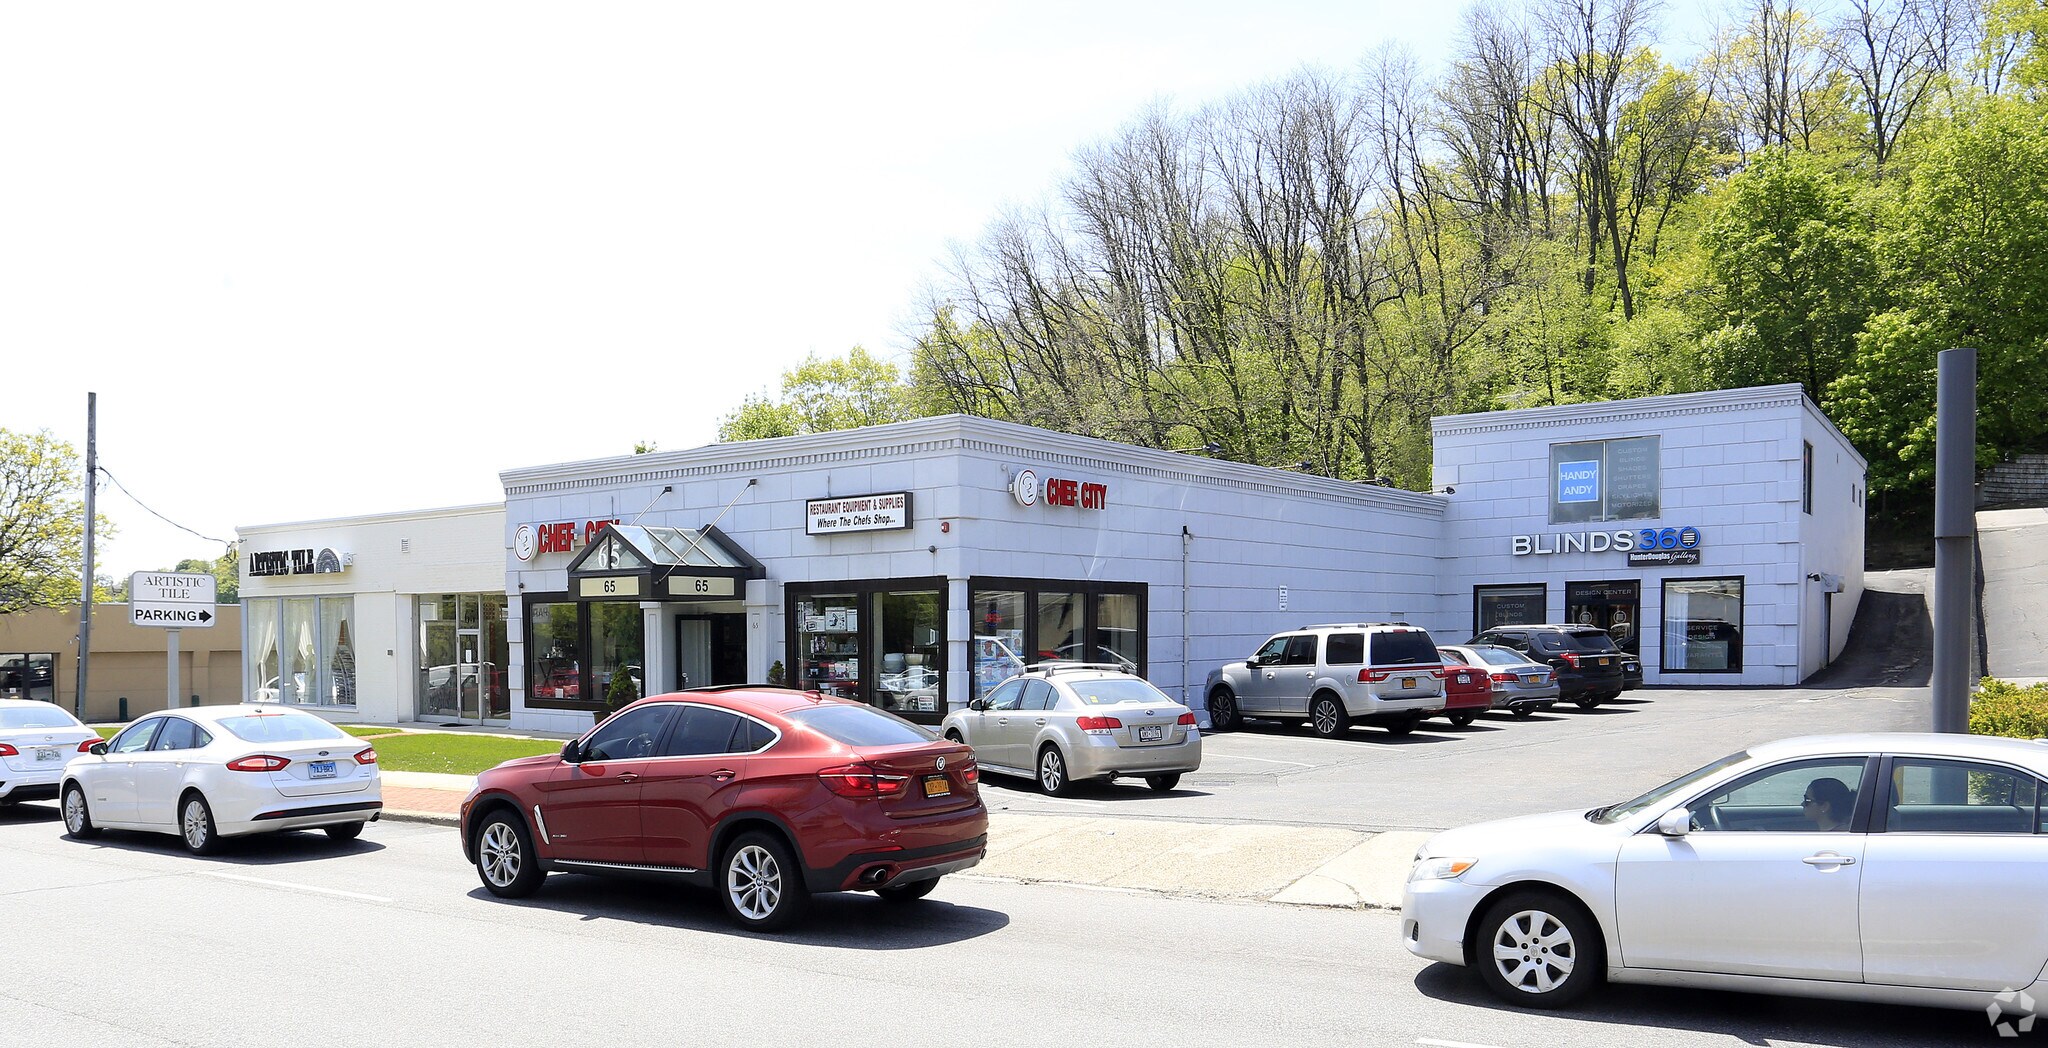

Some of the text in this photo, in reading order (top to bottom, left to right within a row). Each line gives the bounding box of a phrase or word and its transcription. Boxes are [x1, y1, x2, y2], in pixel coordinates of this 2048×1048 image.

[1560, 470, 1597, 481] HANDY
[1045, 477, 1108, 510] CHEF CITY
[1563, 485, 1593, 496] ANDY
[809, 496, 904, 516] RESTAURANT EQUIPMENT & SUPPLIES
[817, 517, 838, 529] Where
[839, 516, 852, 527] The
[853, 514, 872, 526] Chefs
[538, 521, 576, 554] CHEF
[1512, 526, 1701, 556] BLINDS 360
[248, 548, 315, 577] ARTISTIC TILE
[598, 543, 621, 568] 65
[143, 575, 206, 587] ARTISTIC
[604, 580, 616, 593] 65
[695, 579, 709, 593] 65
[158, 587, 190, 600] TILE
[135, 609, 197, 622] PARKING
